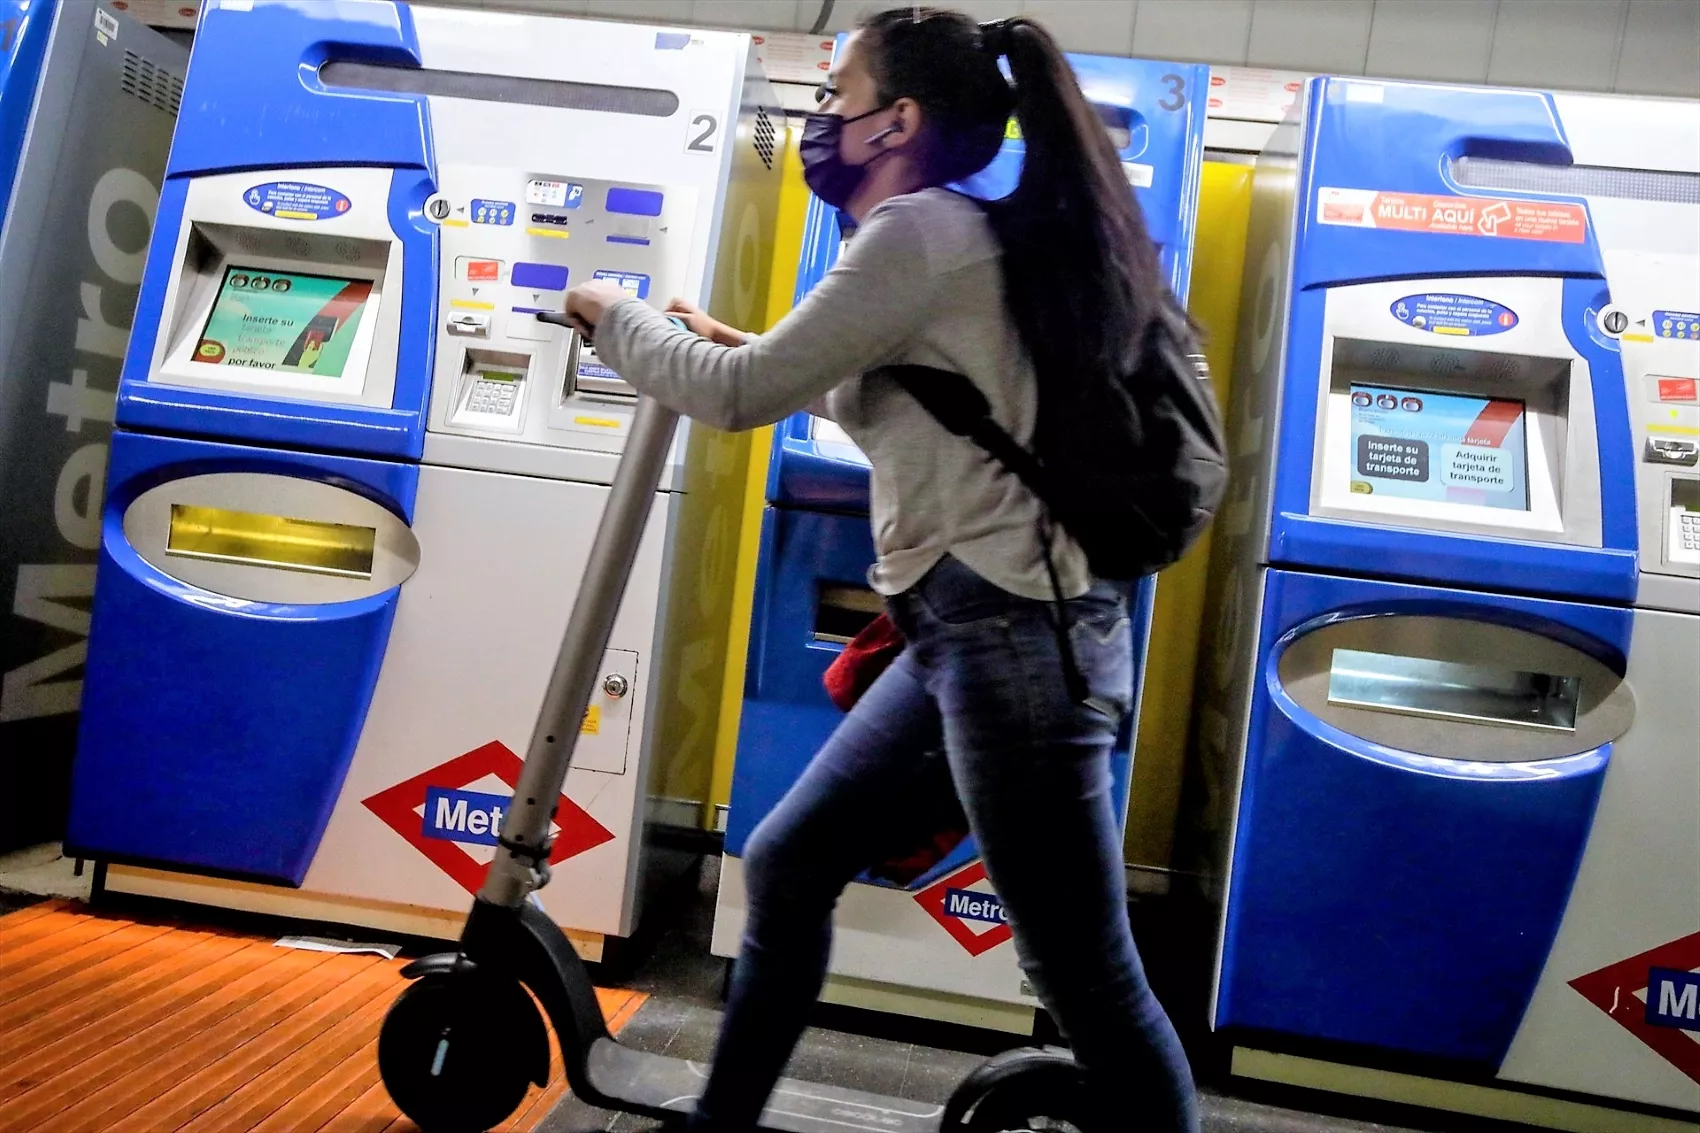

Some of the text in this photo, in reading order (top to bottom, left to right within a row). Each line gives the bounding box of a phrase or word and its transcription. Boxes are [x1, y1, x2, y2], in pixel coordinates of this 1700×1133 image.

[1157, 73, 1186, 112] 3
[687, 114, 718, 152] 2
[1378, 203, 1475, 224] MULTI AQUÍ
[242, 313, 294, 327] Inserte su
[228, 357, 277, 369] por favor
[1, 167, 161, 722] Metro
[1368, 440, 1419, 455] Inserte su
[1467, 437, 1491, 446] tarjeta
[1368, 452, 1417, 465] tarjeta de
[1455, 451, 1499, 463] Adquirir
[1366, 463, 1420, 477] transporte
[1452, 461, 1501, 474] tarjeta de
[1450, 472, 1504, 485] transporte
[435, 796, 503, 838] Met
